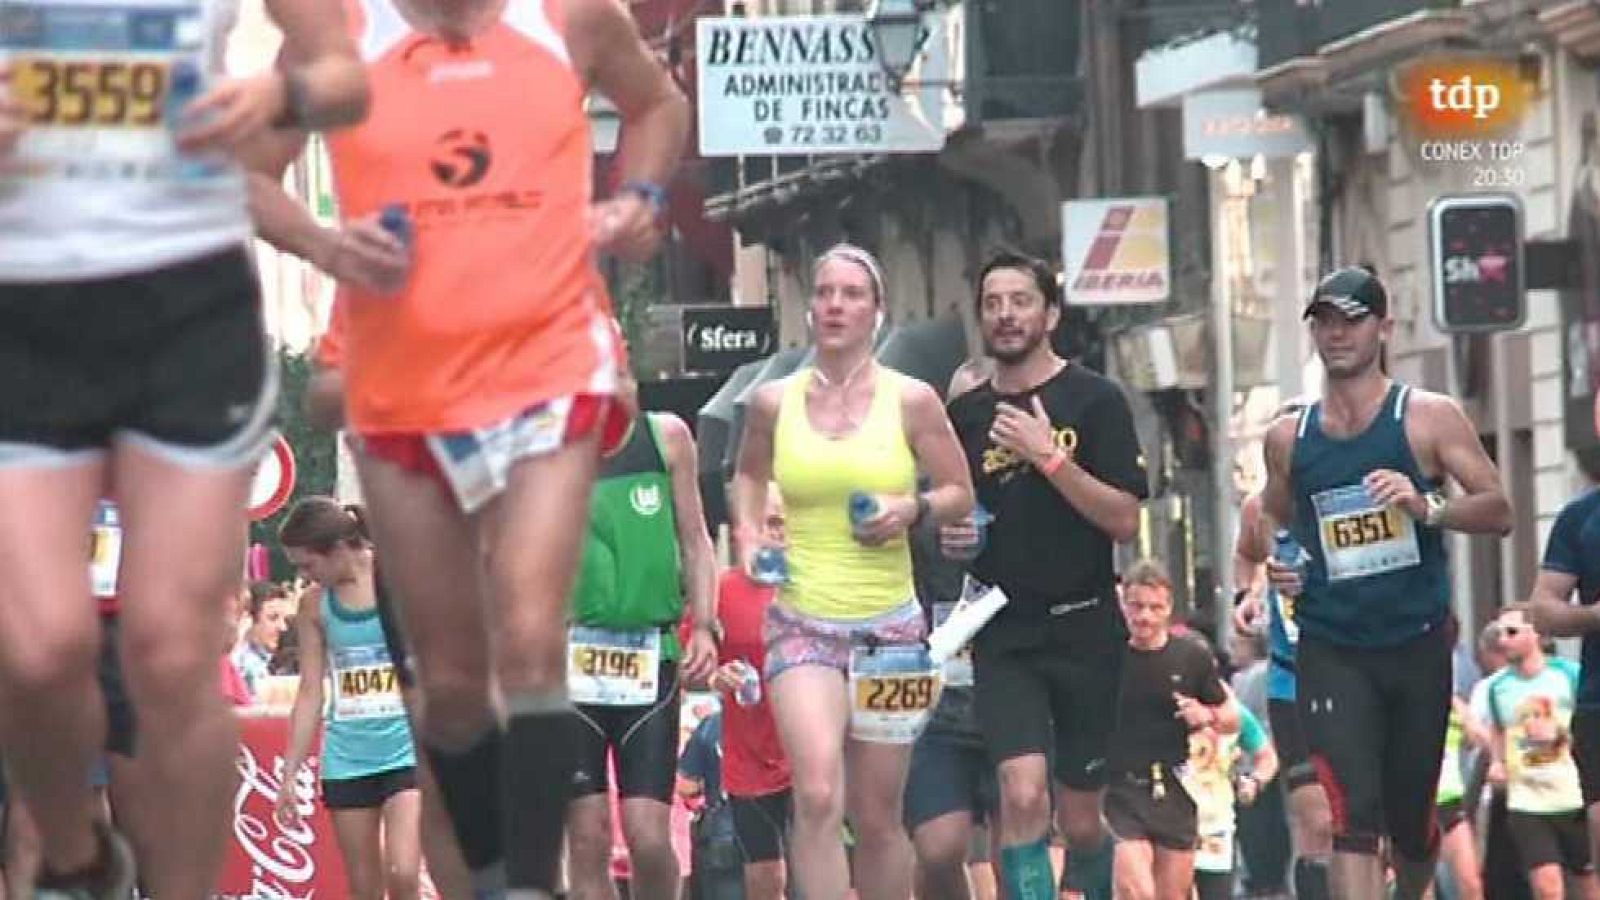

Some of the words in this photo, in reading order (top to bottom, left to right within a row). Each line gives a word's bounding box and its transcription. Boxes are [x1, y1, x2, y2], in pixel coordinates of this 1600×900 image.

[707, 24, 930, 65] BENNASS
[30, 61, 163, 125] 3559
[754, 98, 783, 122] DE
[801, 96, 889, 121] FINCAS
[790, 126, 814, 143] 72
[822, 126, 847, 143] 32
[854, 125, 881, 142] 63
[1073, 271, 1164, 291] IBERIA
[1333, 510, 1394, 548] 6351
[342, 668, 395, 697] 4047
[866, 677, 932, 711] 2269
